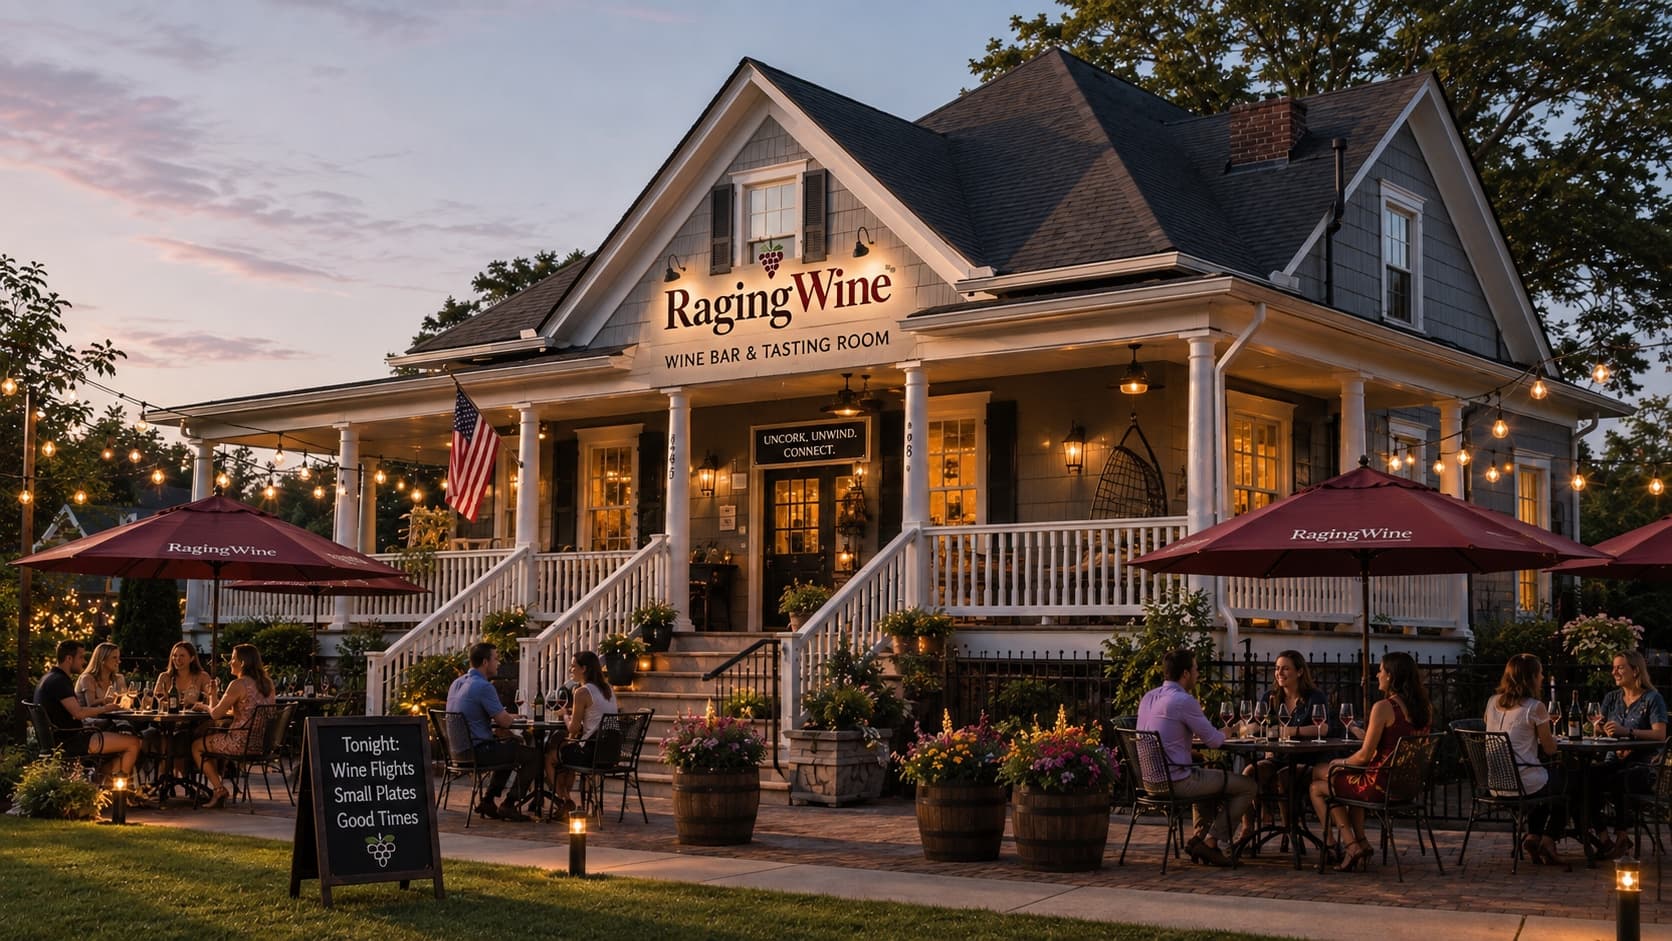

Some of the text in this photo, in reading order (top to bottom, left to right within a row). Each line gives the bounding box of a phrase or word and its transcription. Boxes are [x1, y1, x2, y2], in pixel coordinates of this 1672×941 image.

[664, 267, 892, 336] RagingWine
[665, 330, 890, 369] WINE BAR & TASTING ROOM
[763, 428, 857, 445] UNCORK. UNWIND.
[783, 444, 836, 458] CONNECT.
[1290, 527, 1413, 542] RagingWine
[167, 542, 277, 557] RagingWine
[341, 735, 400, 756] Tonight:
[331, 760, 415, 780] Wine Flights
[334, 784, 417, 803] Small Plates
[337, 810, 419, 828] Good Times
